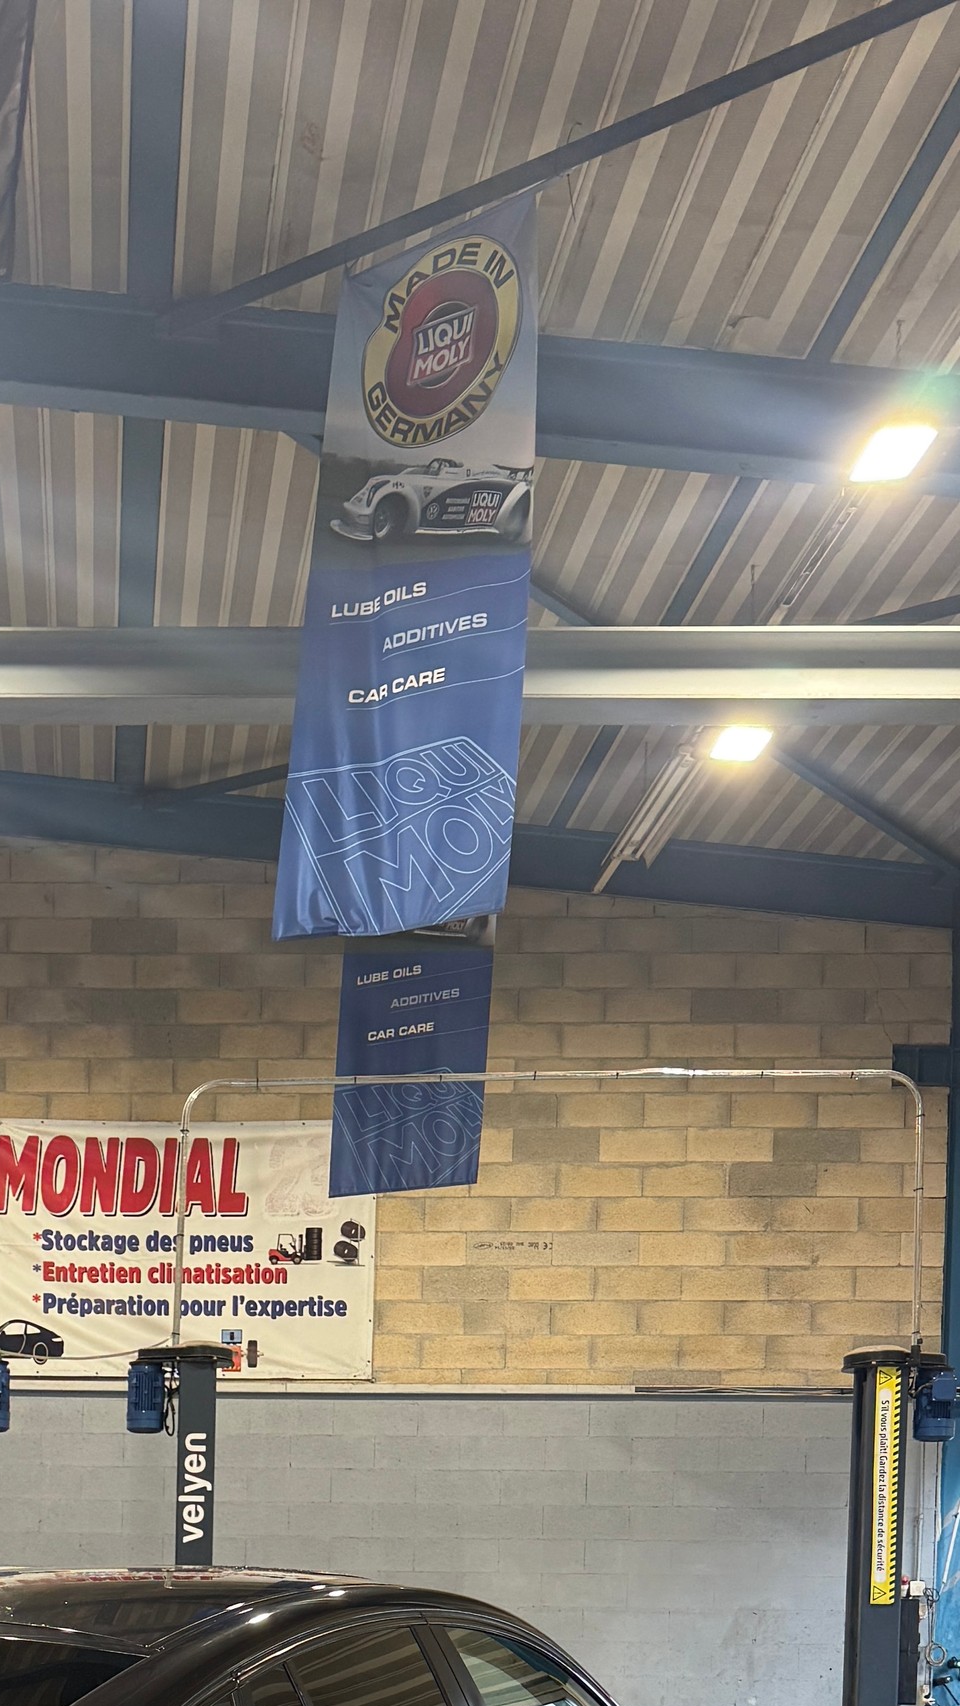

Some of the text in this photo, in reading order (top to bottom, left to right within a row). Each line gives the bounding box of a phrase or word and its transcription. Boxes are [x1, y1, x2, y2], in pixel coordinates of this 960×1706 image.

[384, 241, 516, 334] MADE IN
[416, 313, 476, 356] LIQUI
[412, 340, 472, 381] MOLY
[366, 352, 504, 444] GERMANY
[472, 491, 500, 507] LIQUI
[467, 508, 497, 524] MOLY
[331, 581, 428, 619] LUBE OILS
[382, 612, 488, 654] ADDITIVES
[347, 667, 446, 706] CAR CARE
[302, 741, 496, 844] LIQUI
[357, 964, 422, 986] LUBE OILS
[390, 987, 460, 1009] ADDITIVES
[367, 1021, 435, 1042] CAR CARE
[41, 1229, 140, 1254] Stockage
[189, 1232, 254, 1255] pneus
[42, 1261, 289, 1285] Entretien climatisation
[42, 1292, 348, 1319] Préparation pour l'expertise
[880, 1413, 888, 1432] vous
[879, 1455, 888, 1483] Gardez
[178, 1432, 213, 1544] velyen
[879, 1484, 887, 1492] la
[877, 1493, 887, 1527] distance
[878, 1528, 886, 1538] de
[876, 1540, 886, 1572] sécurité
